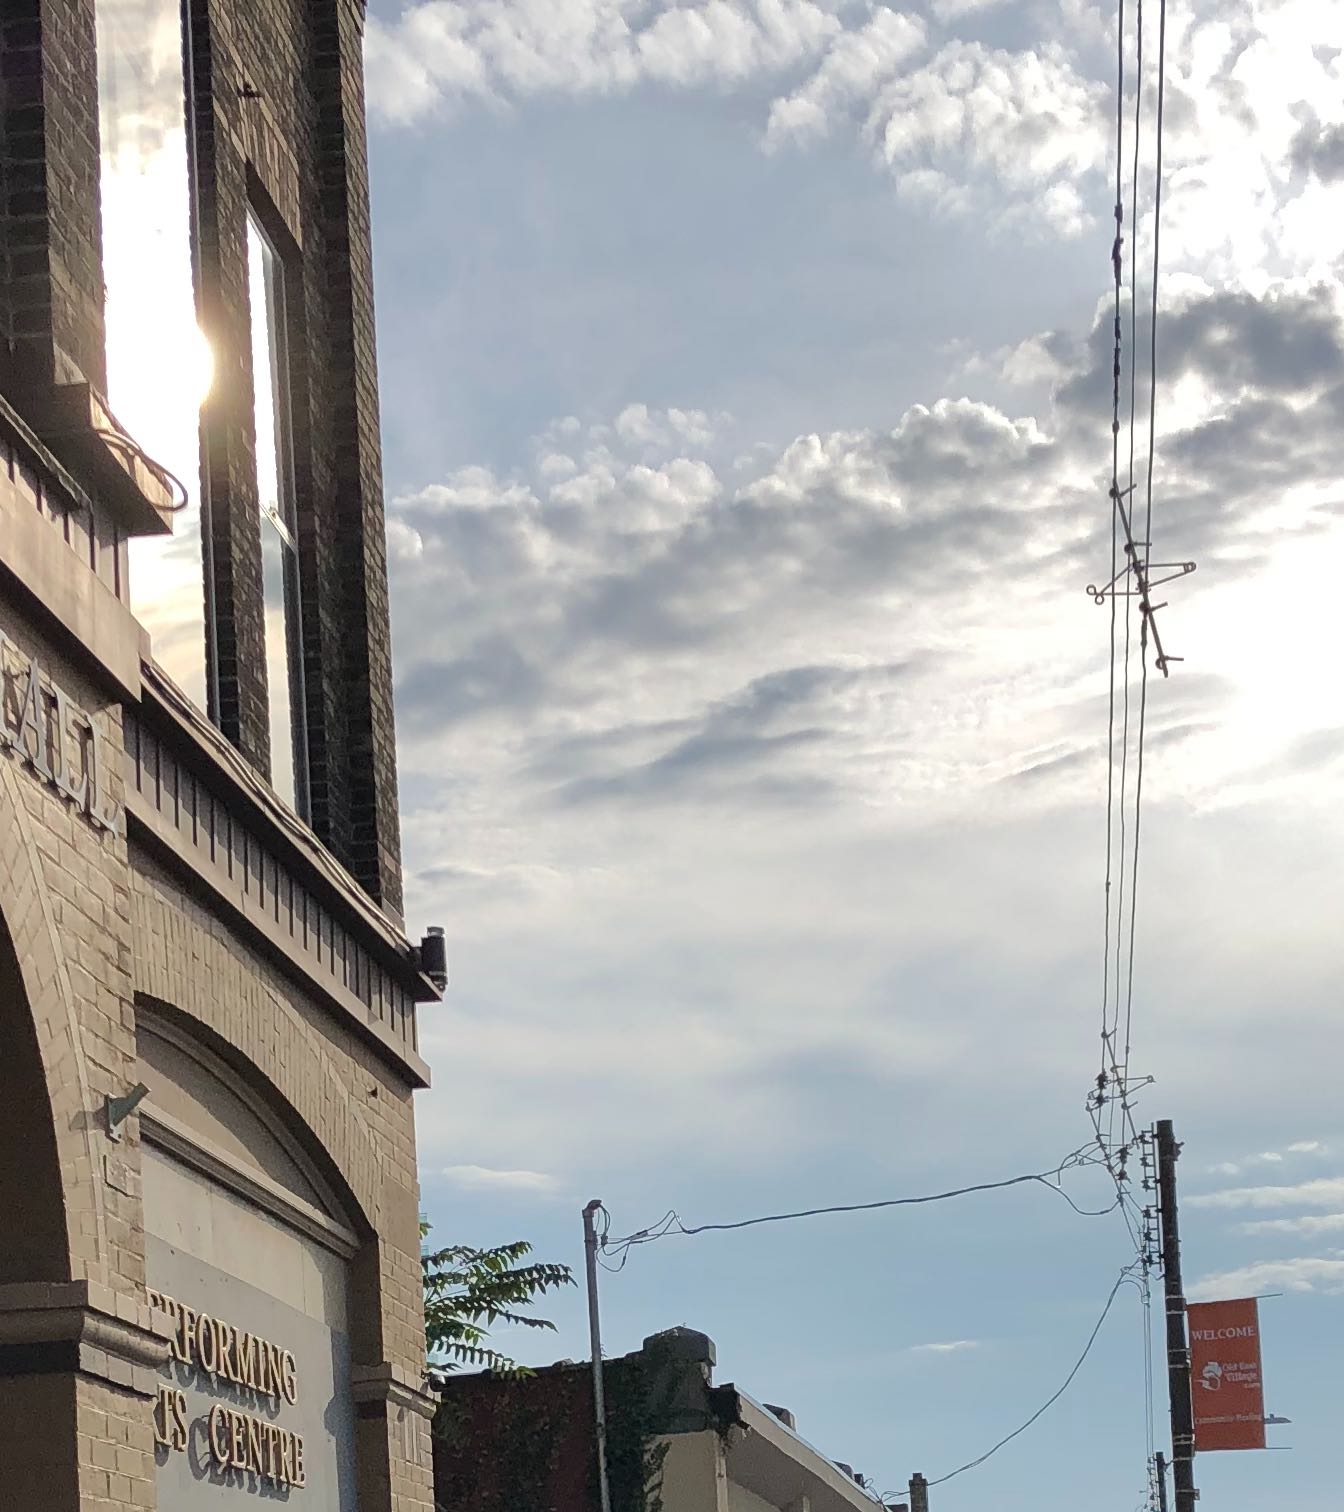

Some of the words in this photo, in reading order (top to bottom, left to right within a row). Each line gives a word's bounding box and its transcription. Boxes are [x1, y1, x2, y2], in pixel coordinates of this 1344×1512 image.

[145, 1286, 298, 1406] FORMING
[1191, 1325, 1256, 1341] WELCOME
[1224, 1371, 1257, 1382] Village
[153, 1383, 189, 1452] TS
[207, 1403, 306, 1489] CENTRE
